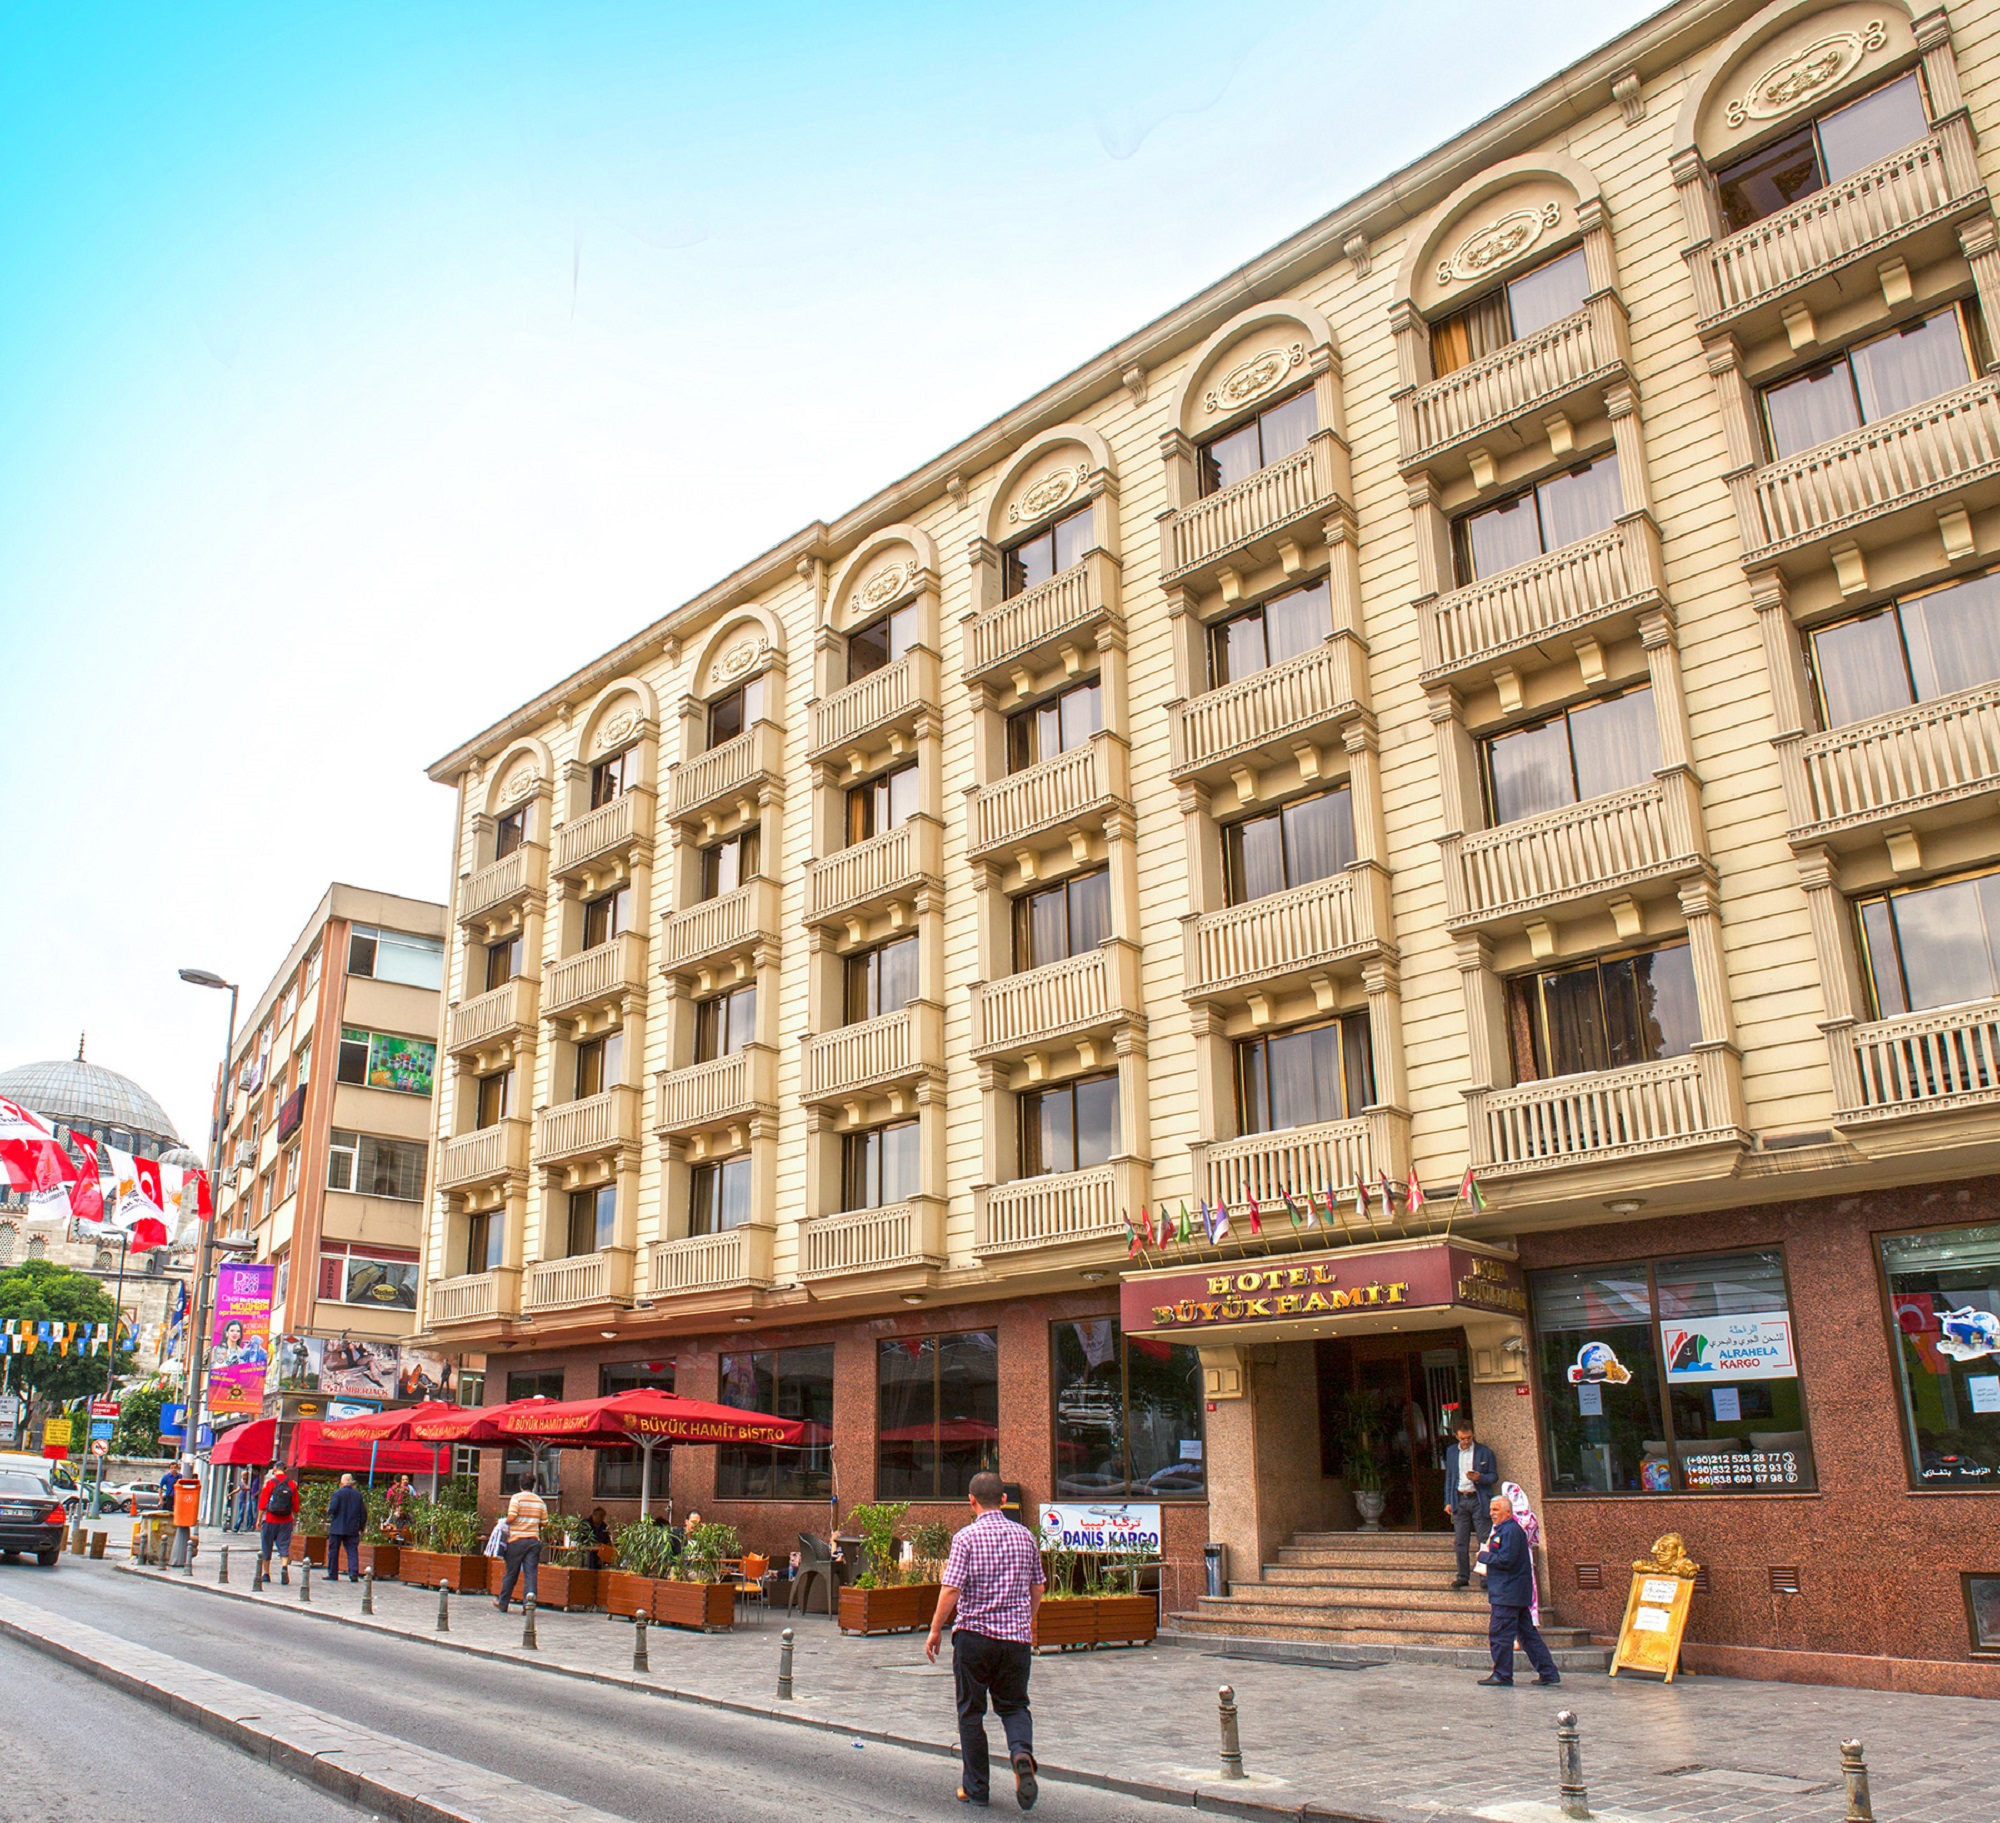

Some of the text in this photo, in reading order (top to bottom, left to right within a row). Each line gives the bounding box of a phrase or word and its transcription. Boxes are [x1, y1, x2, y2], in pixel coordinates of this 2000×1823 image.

[1207, 1264, 1336, 1296] HOTEL
[1719, 1346, 1779, 1359] ALRAHELA
[1720, 1358, 1760, 1369] KARGO
[515, 1413, 589, 1431] BÜYÜK HAMİT BİSTRO
[640, 1416, 785, 1441] BÜYÜK HAMİT BİSTRO
[359, 1440, 401, 1451] MASTA
[1731, 1454, 1750, 1464] 528
[1752, 1453, 1765, 1463] 28
[1767, 1453, 1780, 1462] 77
[1733, 1464, 1752, 1474] 243
[1753, 1464, 1767, 1473] 62
[1768, 1463, 1782, 1472] 93
[1733, 1474, 1753, 1484] 609
[1755, 1474, 1768, 1483] 67
[1109, 1532, 1159, 1549] KARGO
